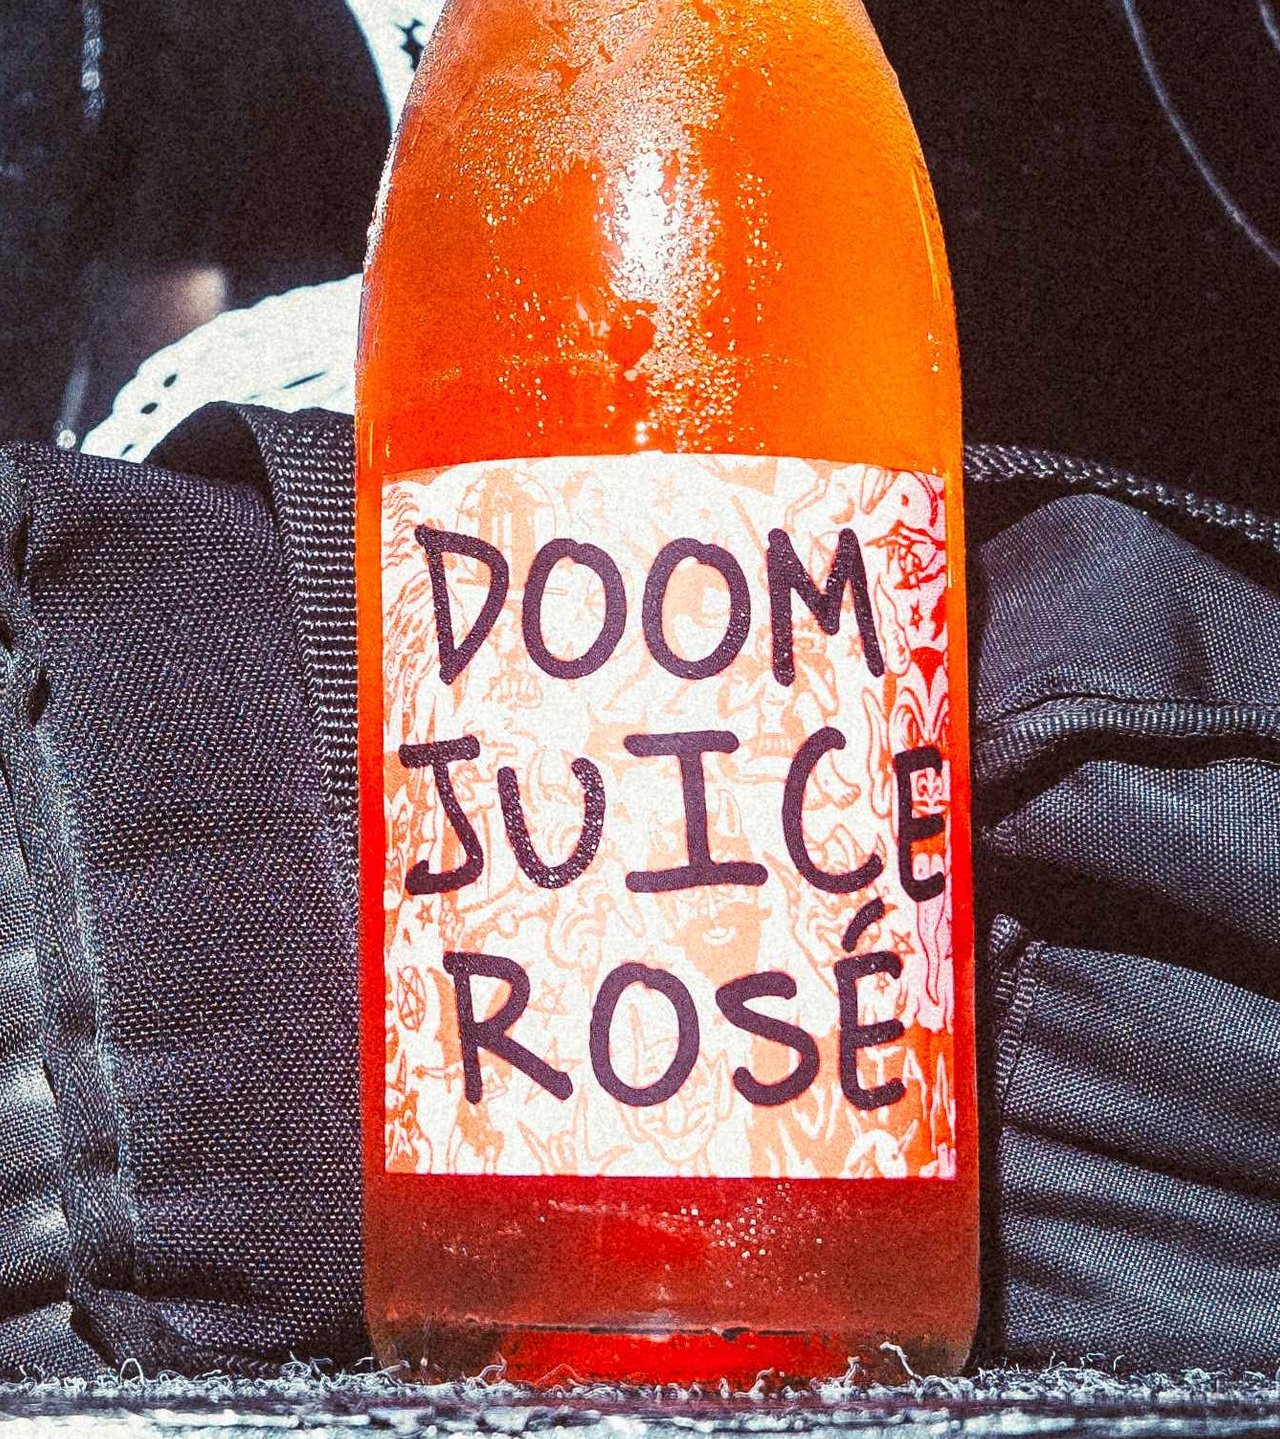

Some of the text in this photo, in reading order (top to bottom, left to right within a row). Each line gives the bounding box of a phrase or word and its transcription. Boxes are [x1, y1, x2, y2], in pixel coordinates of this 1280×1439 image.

[414, 524, 885, 687] DOOM
[398, 727, 947, 903] JUICE
[442, 897, 906, 1110] ROSÉ
